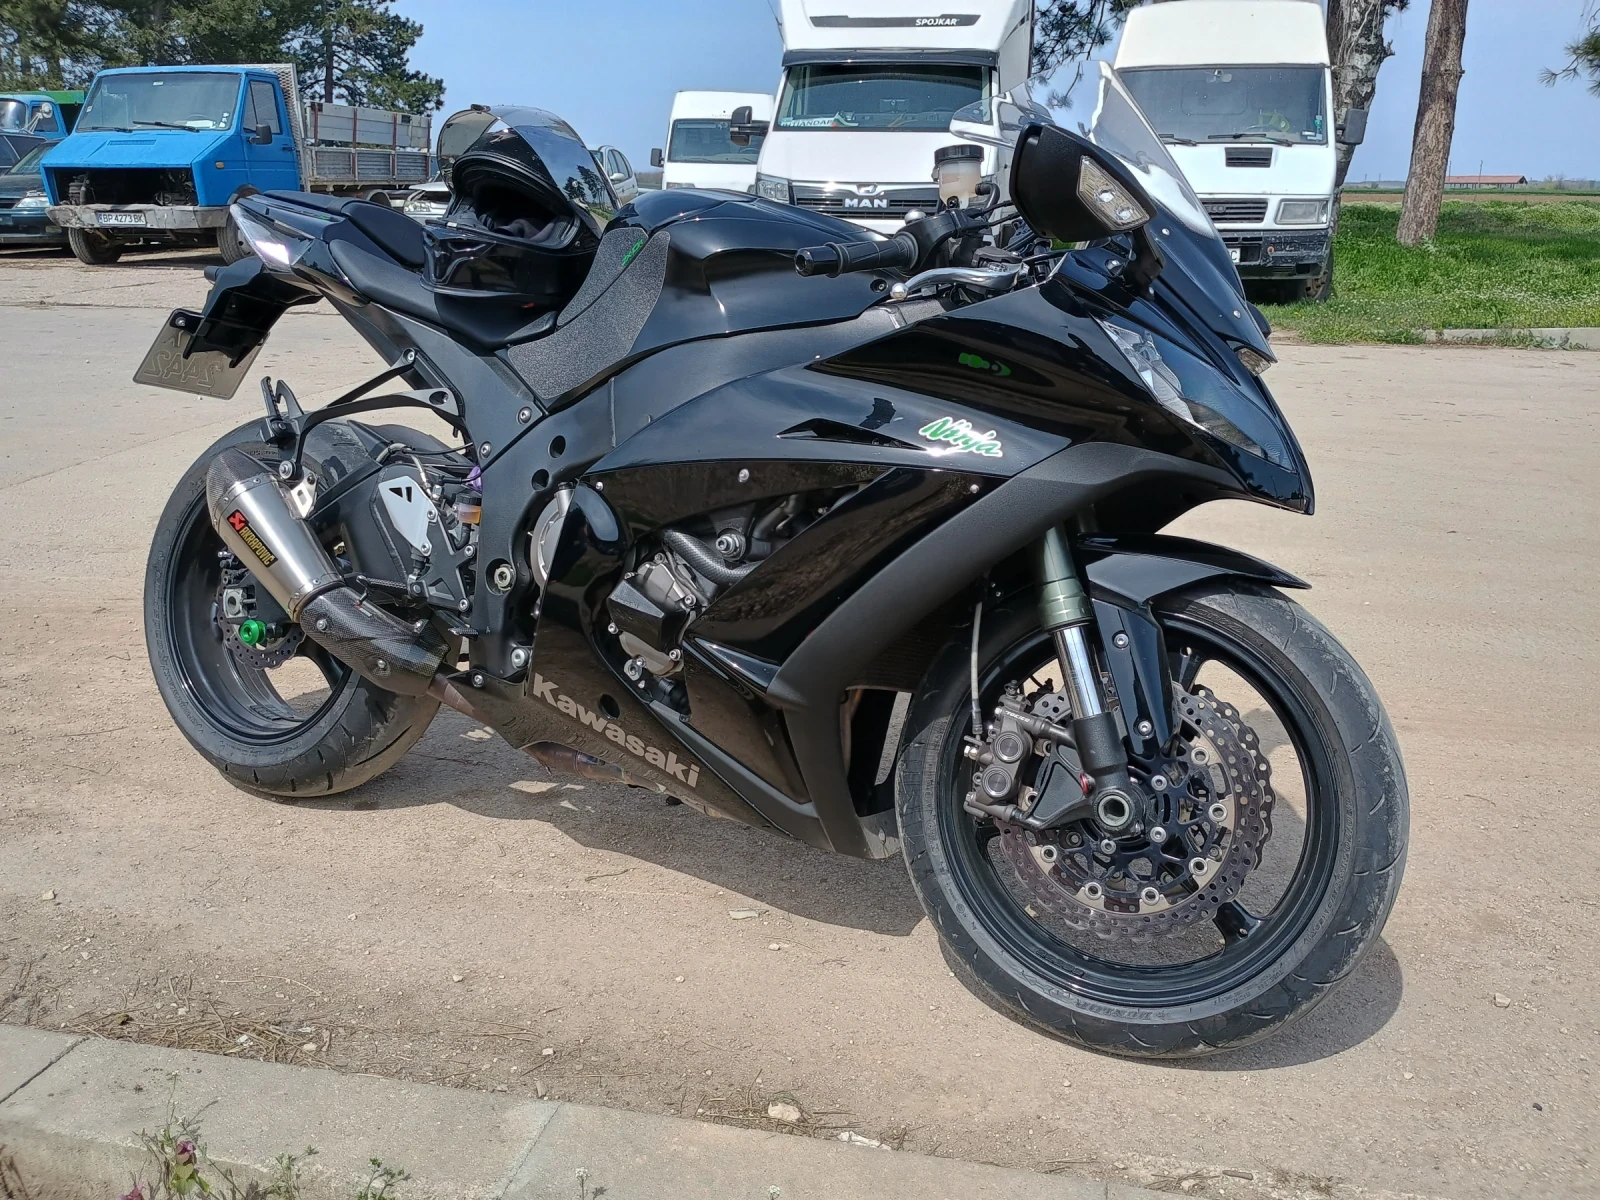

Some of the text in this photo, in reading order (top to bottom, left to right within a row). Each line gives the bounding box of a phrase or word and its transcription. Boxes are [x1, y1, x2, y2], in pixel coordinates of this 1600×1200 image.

[915, 18, 957, 26] SPOJKAR
[844, 198, 888, 208] MAN
[114, 213, 133, 223] 4273
[918, 415, 1004, 458] Ninja
[532, 675, 700, 788] Kawasaki
